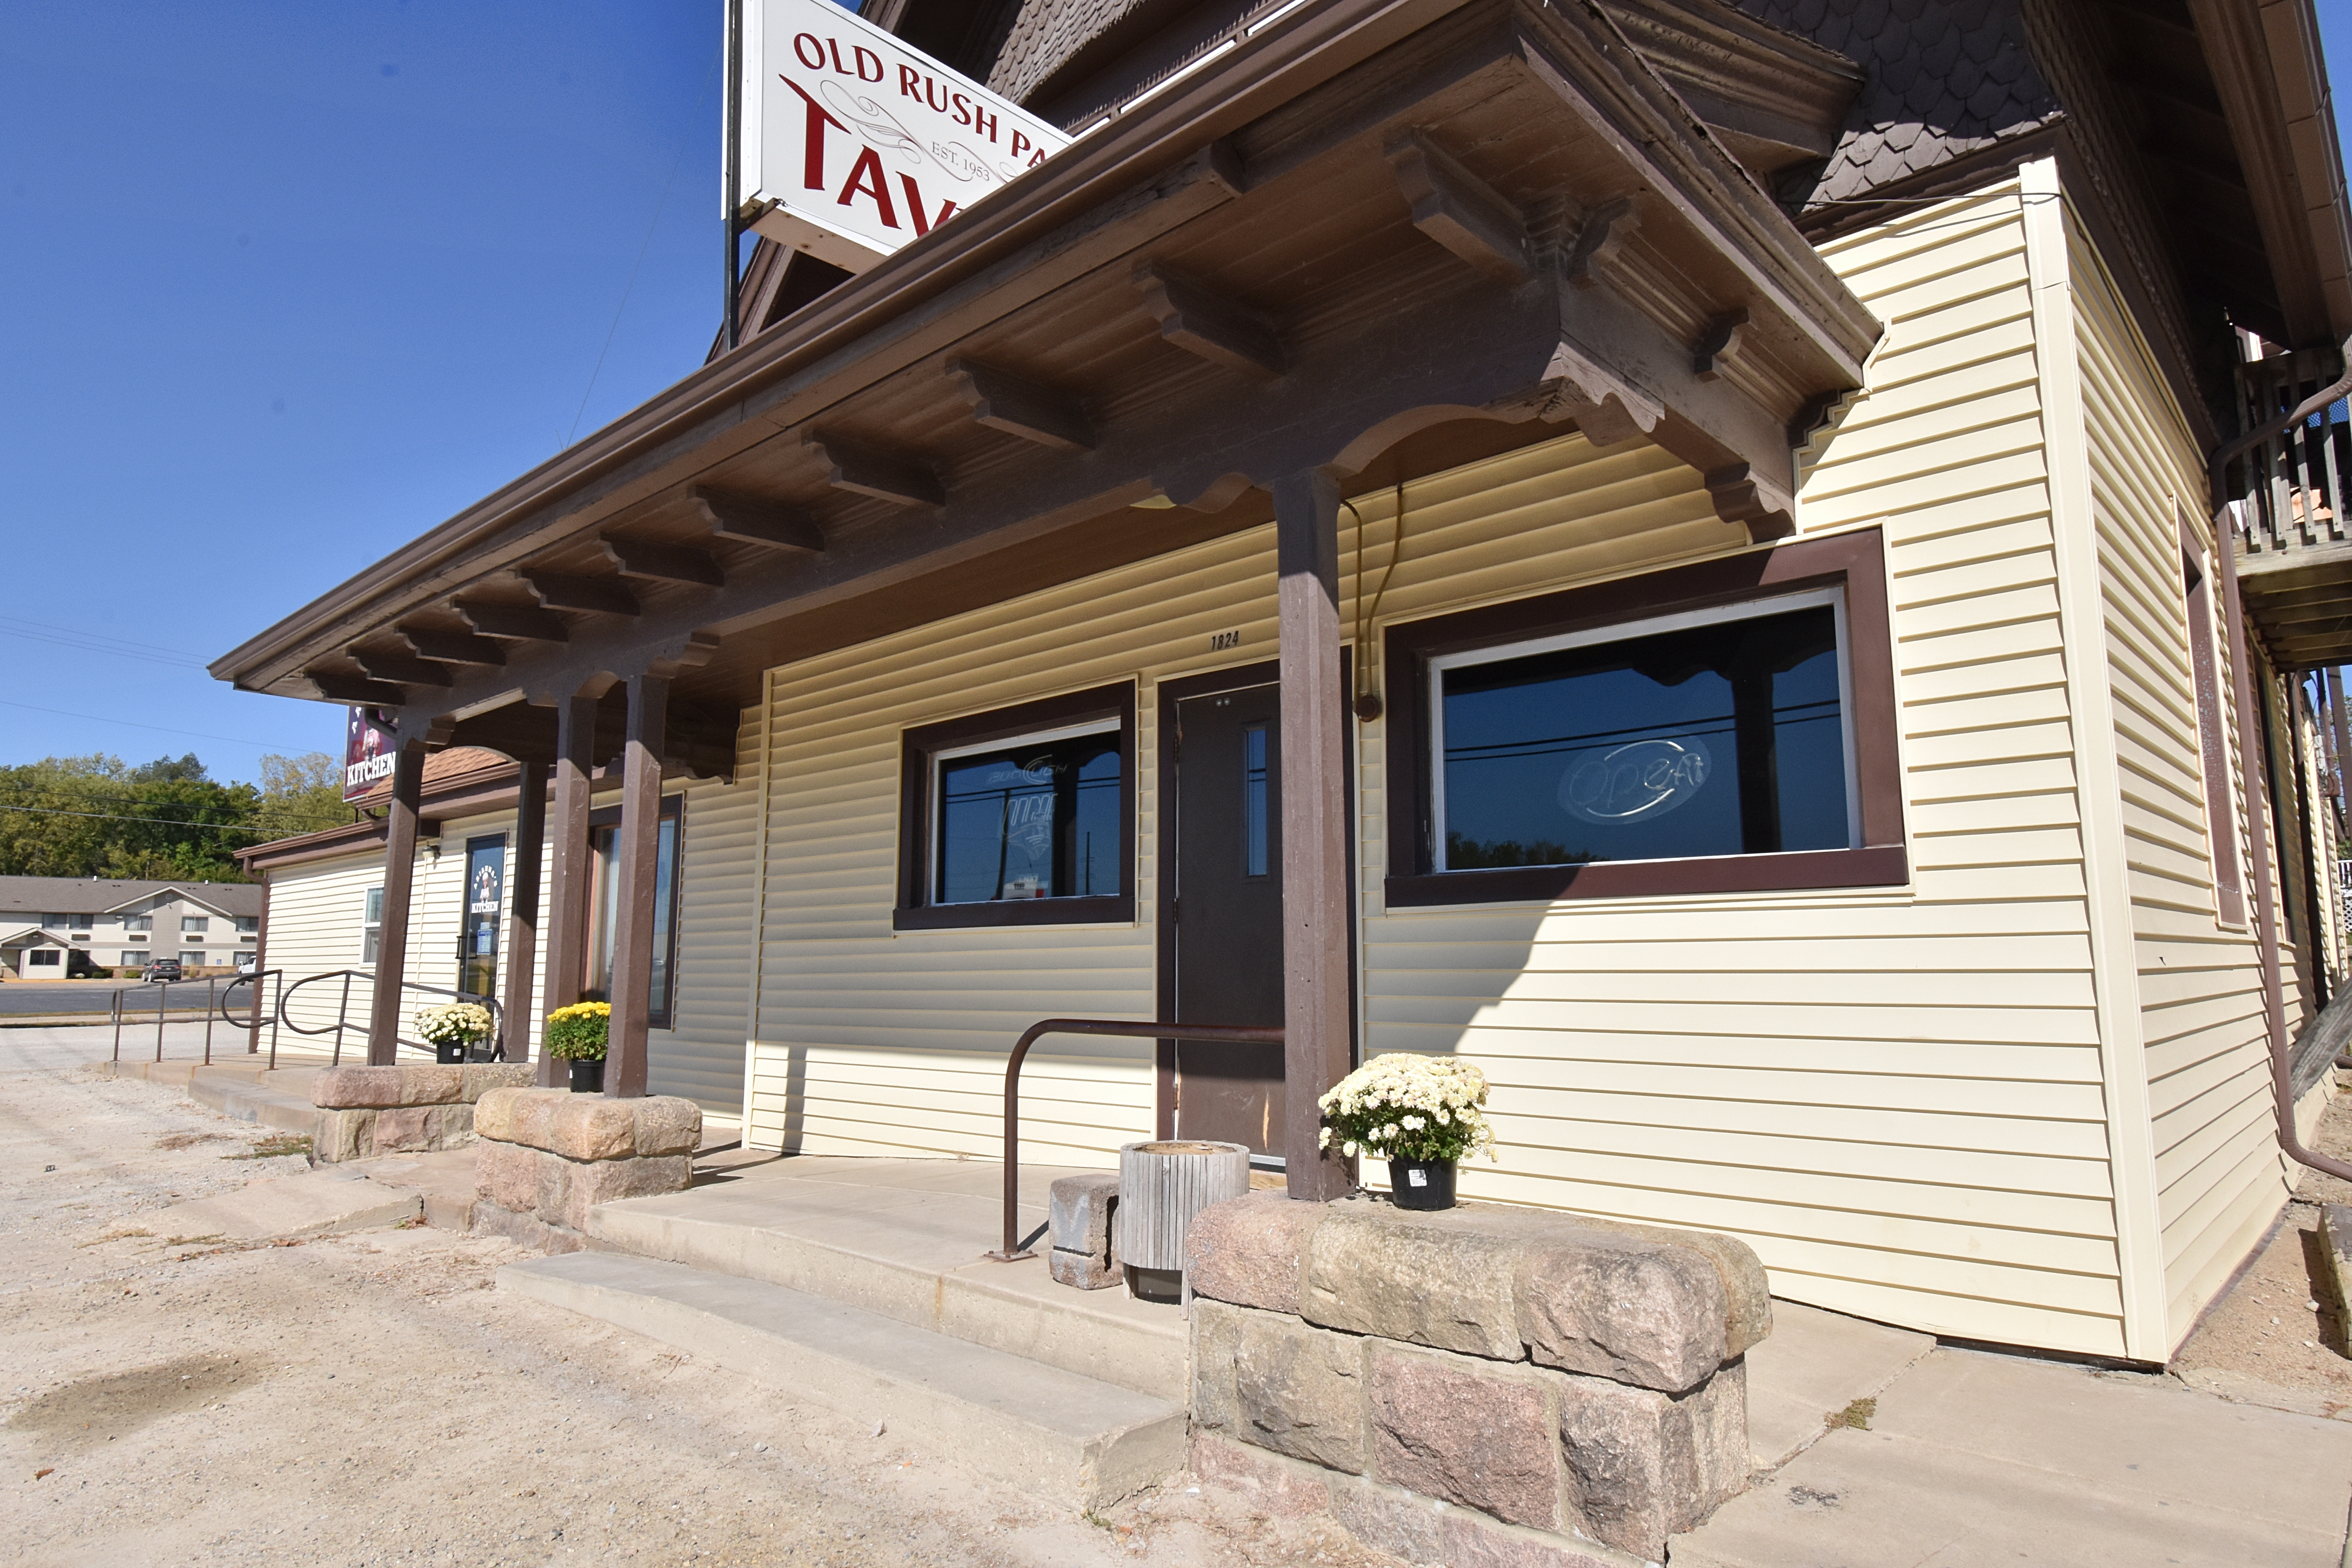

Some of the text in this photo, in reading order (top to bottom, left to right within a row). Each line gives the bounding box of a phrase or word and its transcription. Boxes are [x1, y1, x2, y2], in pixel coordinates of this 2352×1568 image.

[793, 32, 884, 83] OLD
[896, 63, 997, 143] RUSH
[779, 73, 965, 238] TAV
[931, 141, 990, 182] EST. 1953
[1211, 630, 1240, 651] 1824
[346, 751, 396, 787] KITCHEN
[471, 901, 499, 914] KITCHEN
